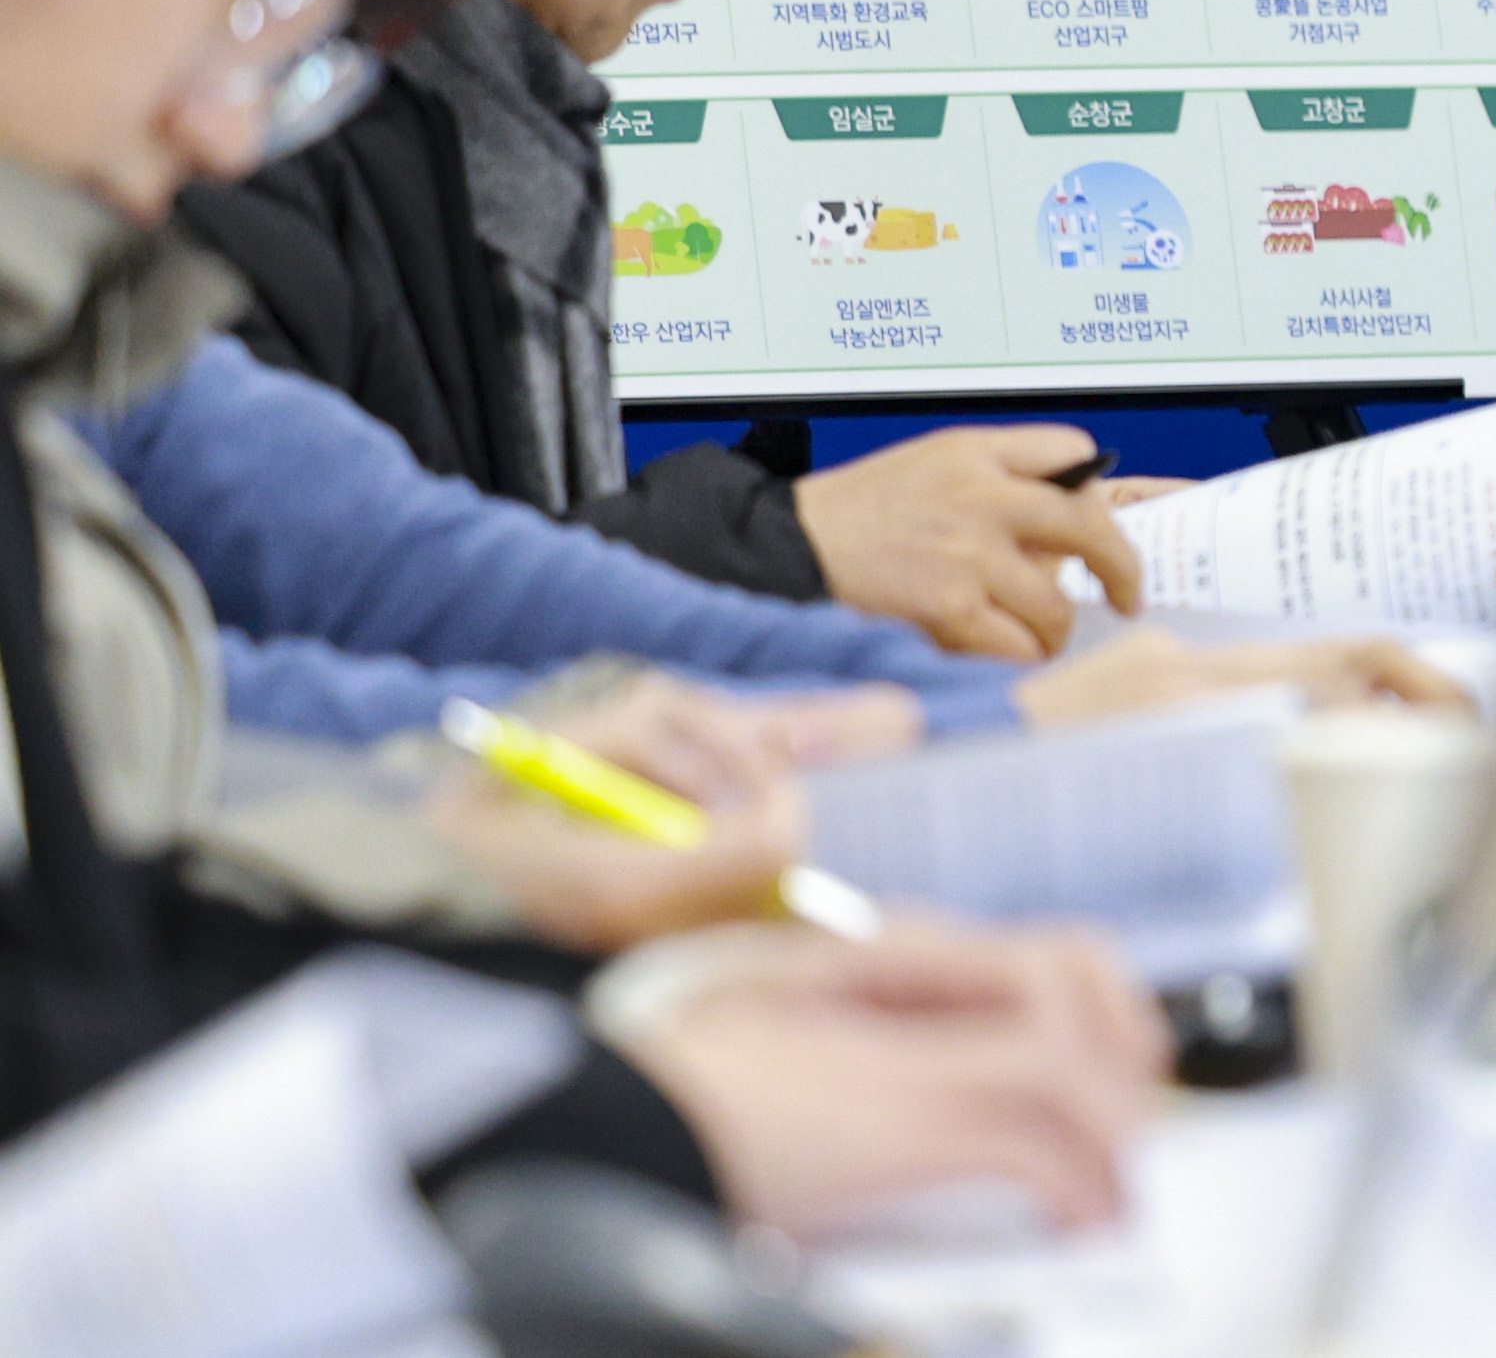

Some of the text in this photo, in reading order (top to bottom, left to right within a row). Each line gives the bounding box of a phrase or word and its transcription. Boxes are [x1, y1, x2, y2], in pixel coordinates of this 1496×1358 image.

[773, 0, 928, 24] 지역특화 환경교육
[1028, 0, 1070, 19] ECO
[817, 28, 891, 51] 시범도시
[1054, 25, 1129, 49] 산업지구
[828, 105, 896, 133] 임실군
[1067, 100, 1133, 128] 순창군
[1302, 96, 1367, 123] 고창군
[836, 298, 930, 321] 임실엔치즈
[1094, 293, 1149, 316] 미생물
[1319, 287, 1392, 310] 사시사철
[656, 319, 732, 343] 산업지구
[830, 324, 943, 350] 낙농산업지구
[1060, 318, 1190, 345] 농생명산업지구
[1286, 313, 1432, 338] 김치특화산업단지
